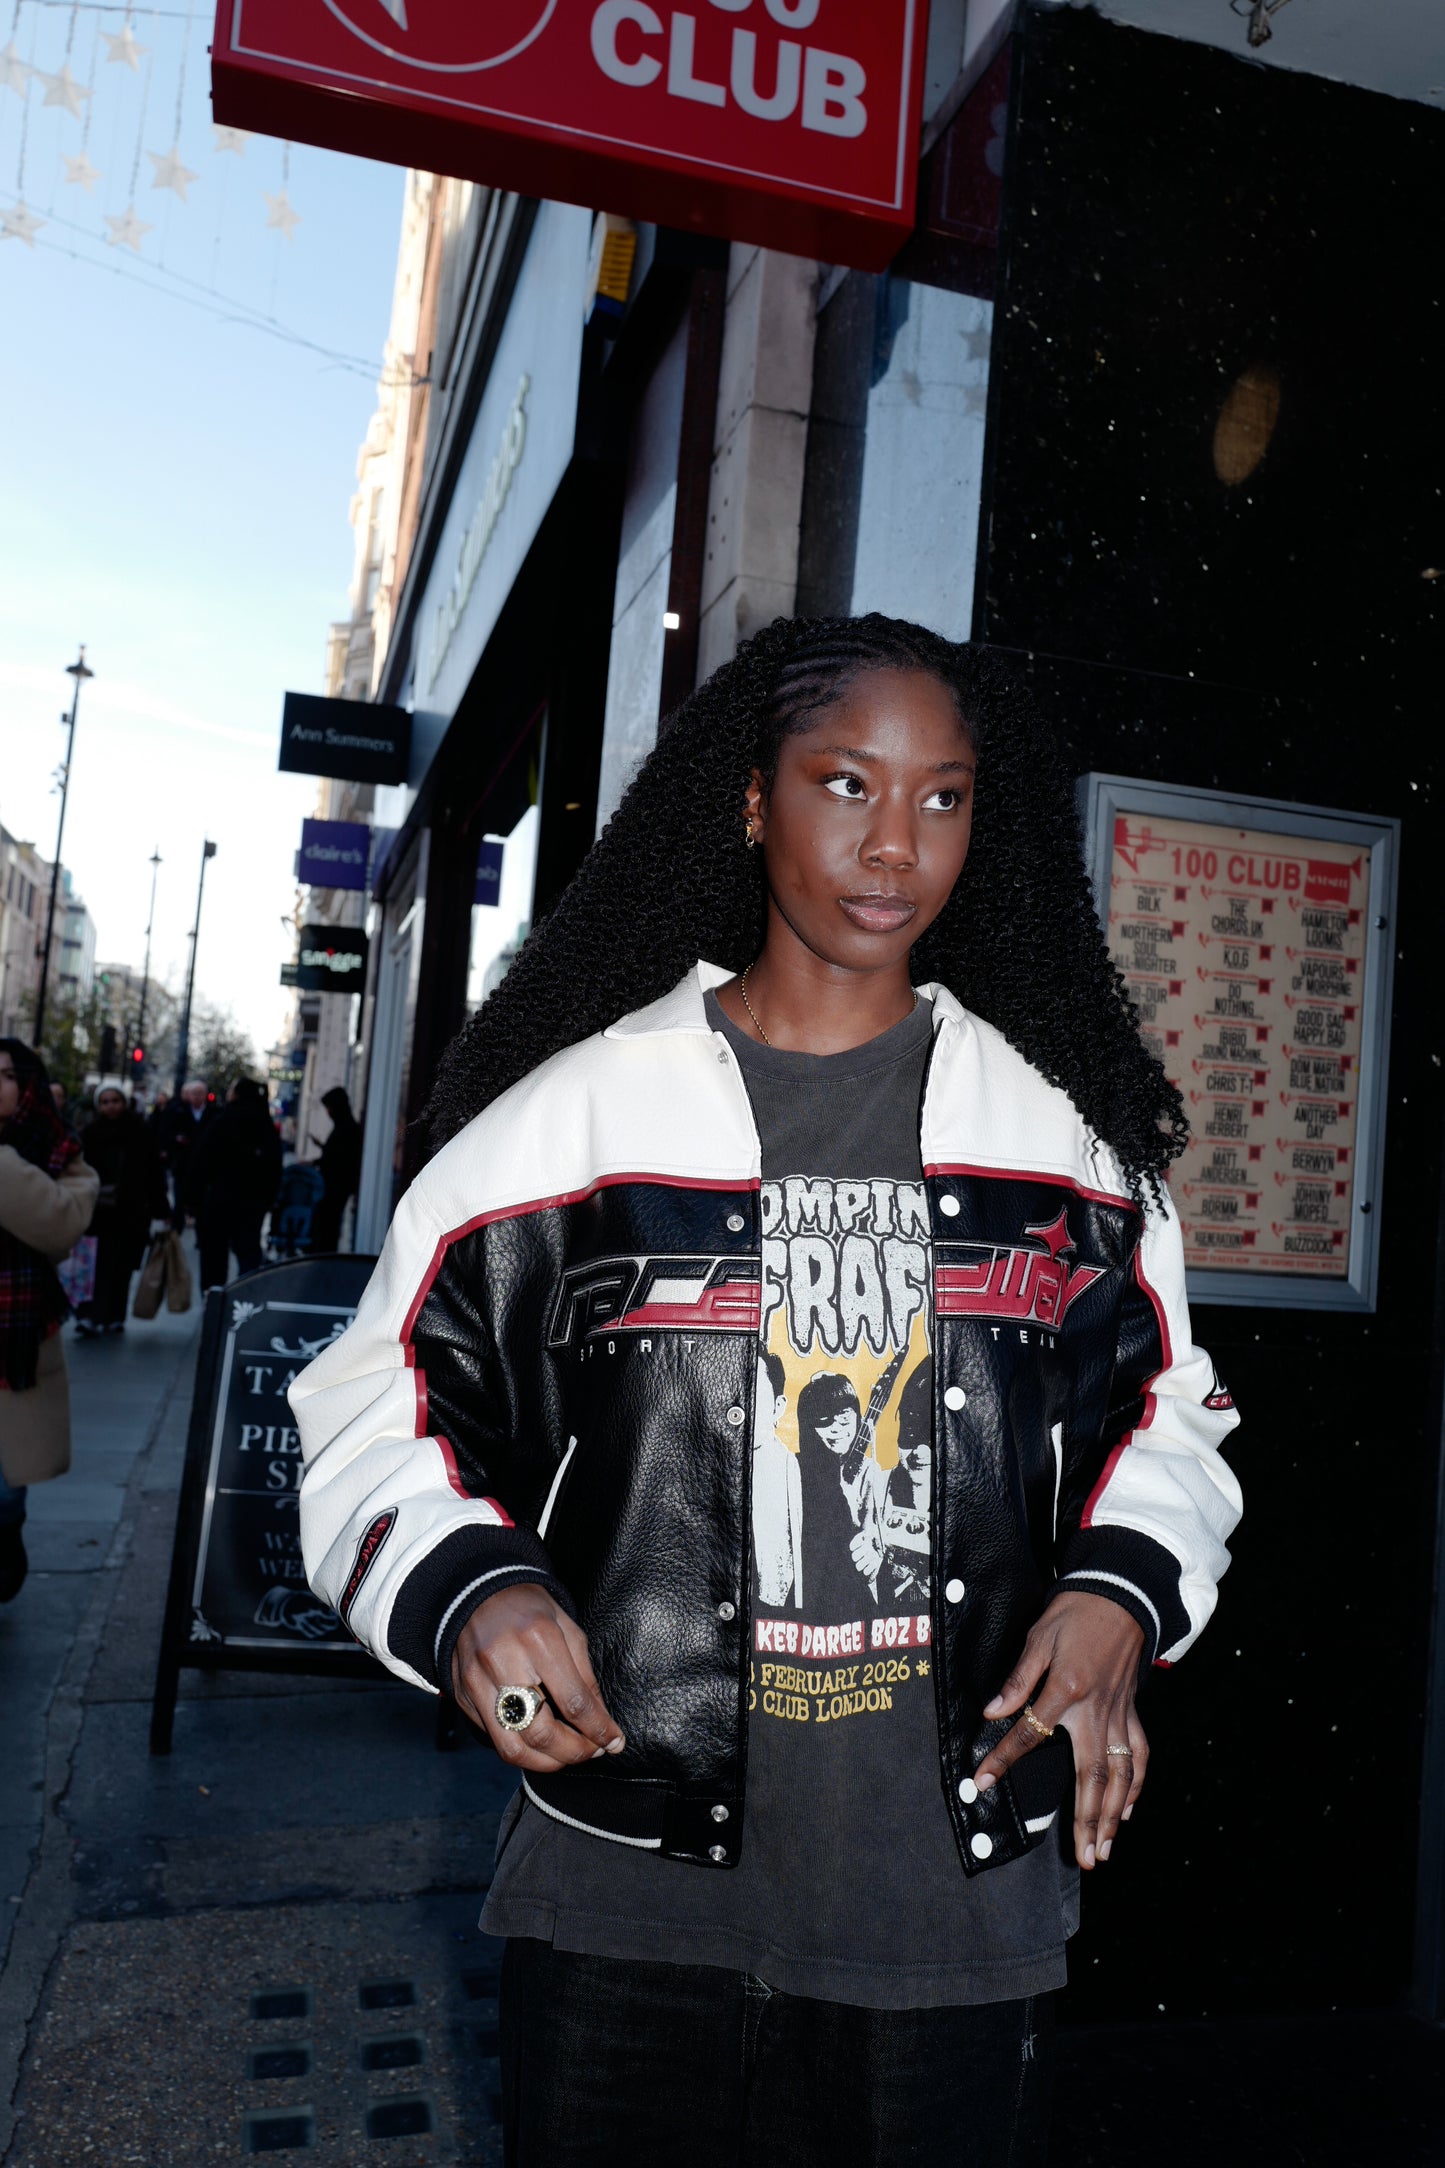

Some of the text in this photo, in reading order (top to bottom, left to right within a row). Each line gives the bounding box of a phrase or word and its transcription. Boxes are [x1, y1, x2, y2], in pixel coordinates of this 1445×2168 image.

[590, 0, 868, 139] CLUB
[290, 723, 395, 753] Ann Summers
[1172, 847, 1300, 891] 100 CLUB
[1137, 896, 1161, 912] BILK
[1230, 902, 1246, 918] THE
[1251, 919, 1264, 936] UK
[1301, 911, 1349, 931] HAMILTON
[1121, 924, 1173, 944] NORTHERN
[1305, 928, 1343, 948] LOOMIS
[1133, 941, 1158, 957] SOUL
[1113, 953, 1177, 974] ALL-NIGHTER
[1300, 961, 1344, 980] VAPOURS
[1228, 982, 1241, 999] DO
[1292, 976, 1352, 997] OF MORPHINE
[1214, 997, 1254, 1017] NOTHING
[1297, 1009, 1324, 1027] GOOD
[1293, 1025, 1325, 1042] HAPPY
[1290, 1058, 1310, 1074] DOM
[1206, 1075, 1237, 1093] CHRIS
[1289, 1073, 1345, 1093] BLUE NATION
[1214, 1107, 1243, 1123] HENRI
[1294, 1106, 1338, 1126] ANOTHER
[1205, 1121, 1249, 1138] HERBERT
[1306, 1122, 1325, 1140] DAY
[1212, 1151, 1237, 1168] MATT
[1292, 1152, 1335, 1171] BERWYN
[1200, 1166, 1247, 1184] ANDERSEN
[1292, 1187, 1332, 1204] JOHNNY
[1284, 1236, 1333, 1254] BUZZCOCKS
[990, 1327, 1055, 1349] TEAM
[580, 1339, 697, 1362] SPORT
[757, 1620, 798, 1654] KEB
[801, 1620, 862, 1657] DARGE
[871, 1617, 911, 1648] BOZ
[760, 1662, 859, 1696] FEBRUARY
[862, 1655, 911, 1686] 2026
[762, 1690, 810, 1722] CLUB
[815, 1687, 893, 1723] LONDON
